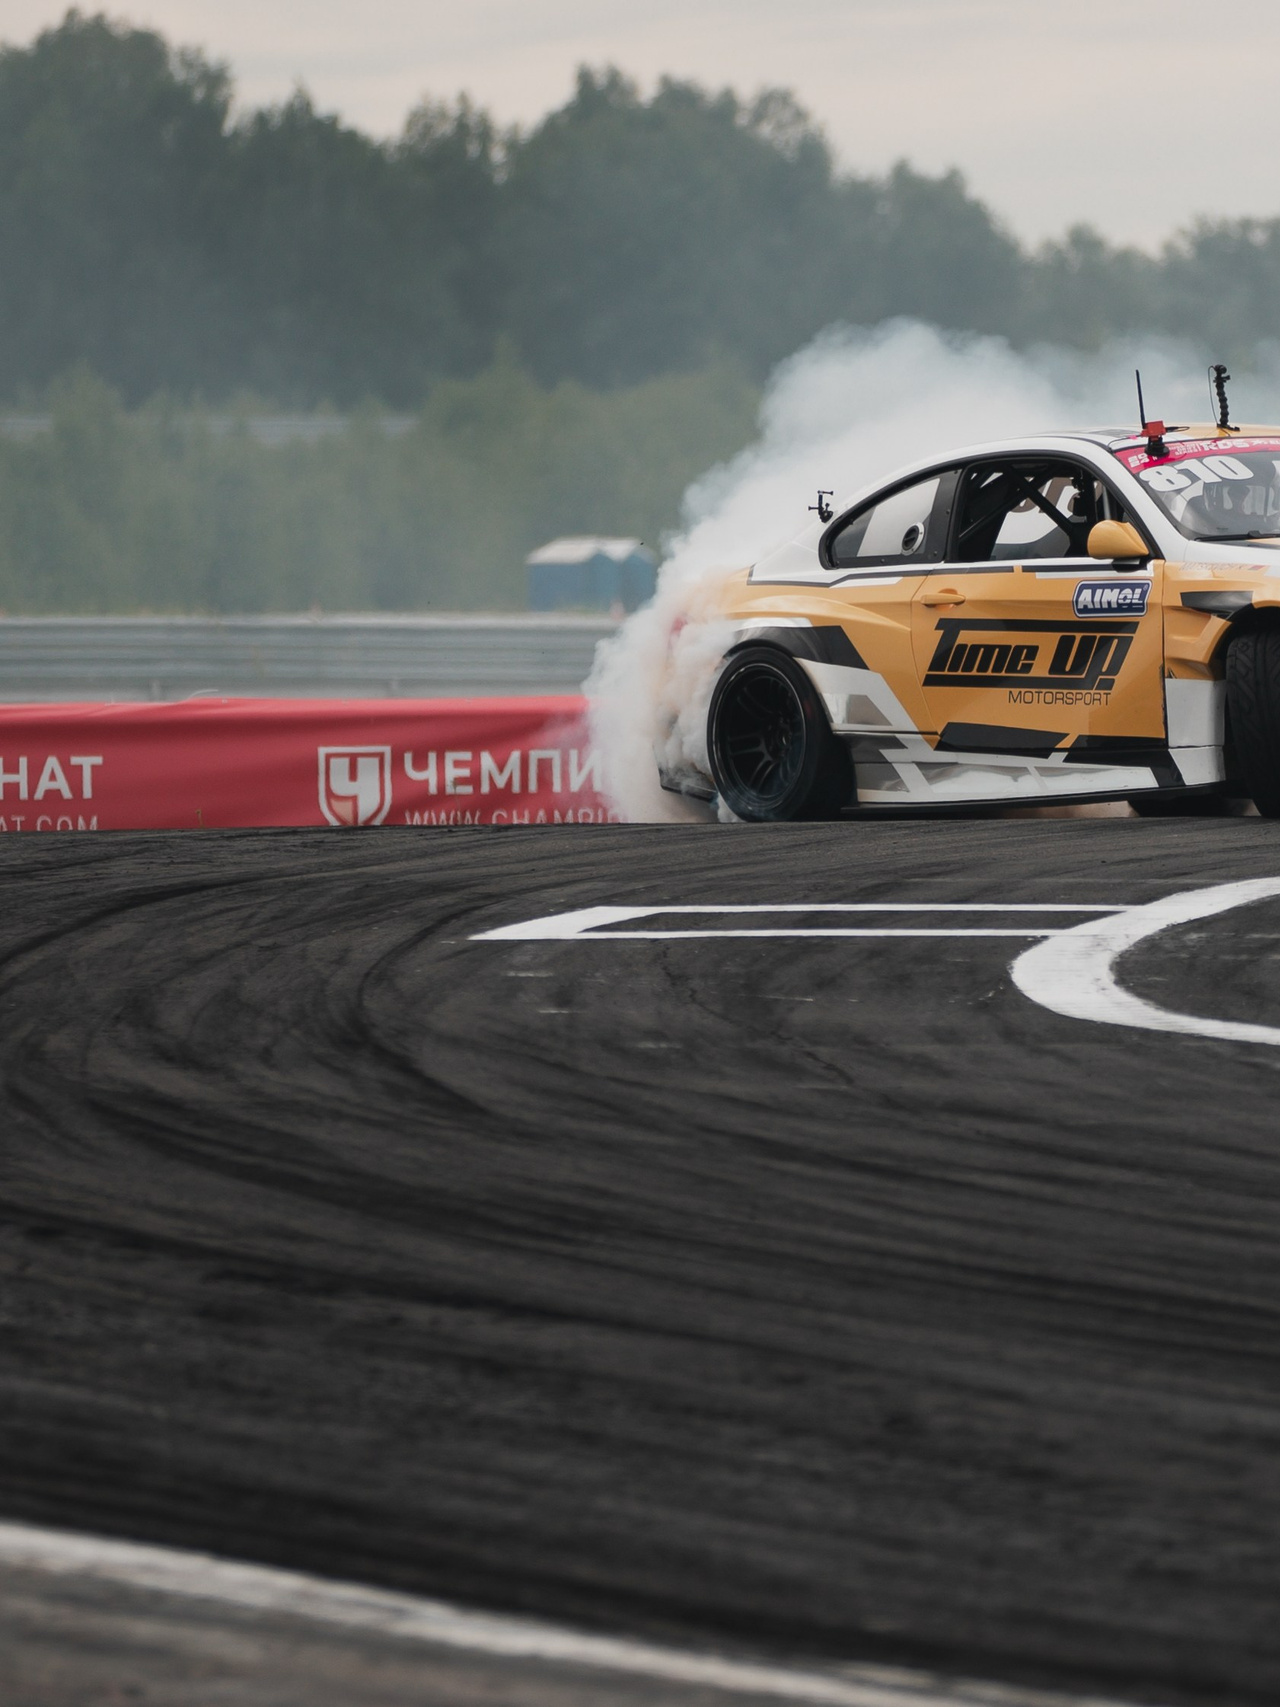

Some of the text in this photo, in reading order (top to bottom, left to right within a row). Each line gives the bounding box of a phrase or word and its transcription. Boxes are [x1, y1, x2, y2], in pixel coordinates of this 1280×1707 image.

[1139, 455, 1254, 492] 810
[1077, 588, 1143, 609] AIMOL
[1008, 689, 1111, 706] MOTORSPORT
[403, 748, 604, 796] ЧЕМПИ
